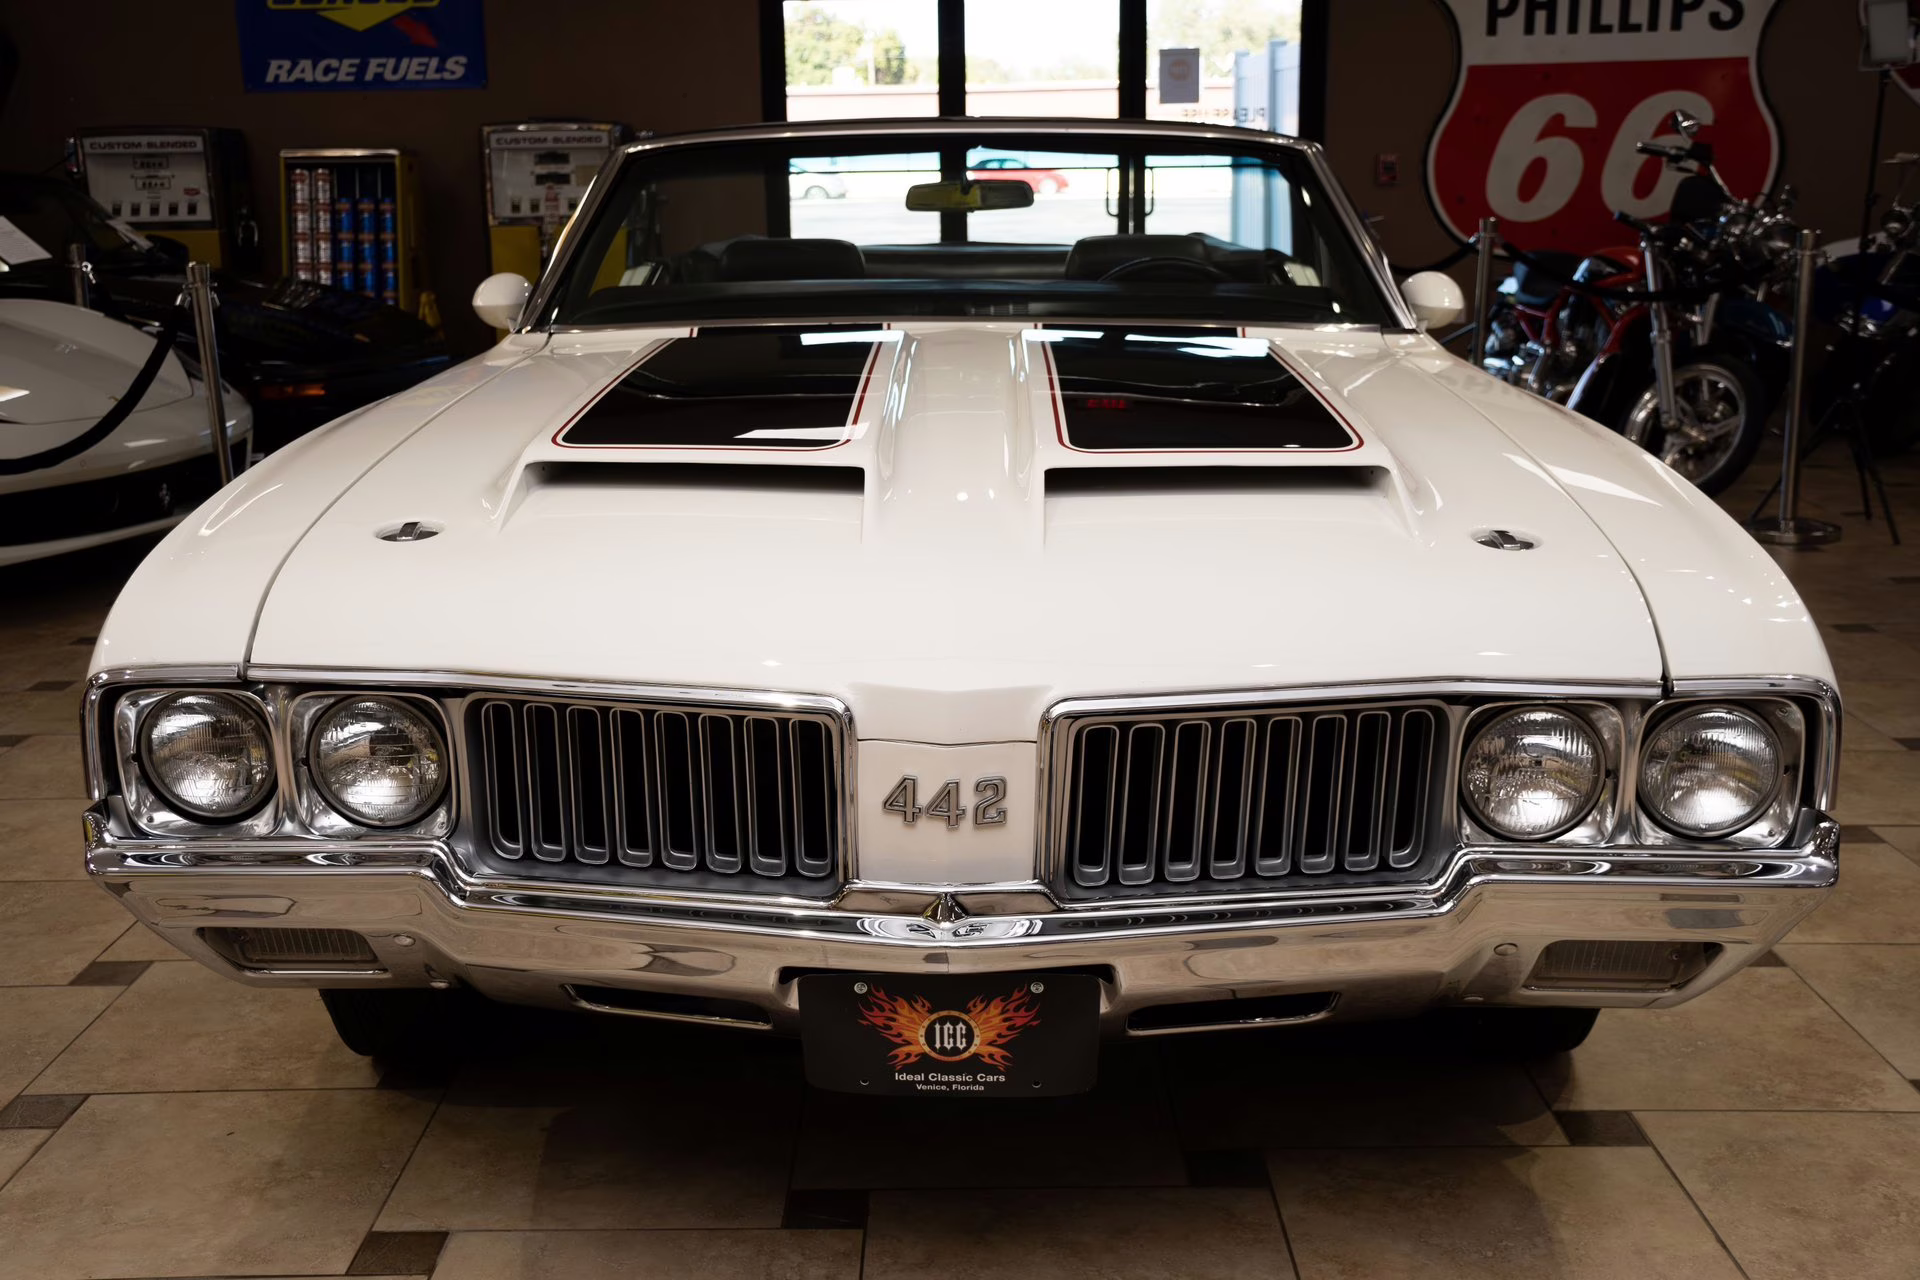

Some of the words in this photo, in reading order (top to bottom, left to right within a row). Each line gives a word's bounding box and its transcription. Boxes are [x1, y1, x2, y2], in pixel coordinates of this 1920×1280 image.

[1485, 0, 1745, 36] PHILLIPS
[265, 58, 360, 83] RACE
[364, 55, 468, 81] FUELS
[1485, 90, 1715, 223] 66
[882, 775, 1008, 829] 442
[895, 1072, 925, 1082] Ideal
[928, 1072, 973, 1082] Classic
[976, 1073, 1006, 1082] Cars
[952, 1083, 985, 1091] Florida
